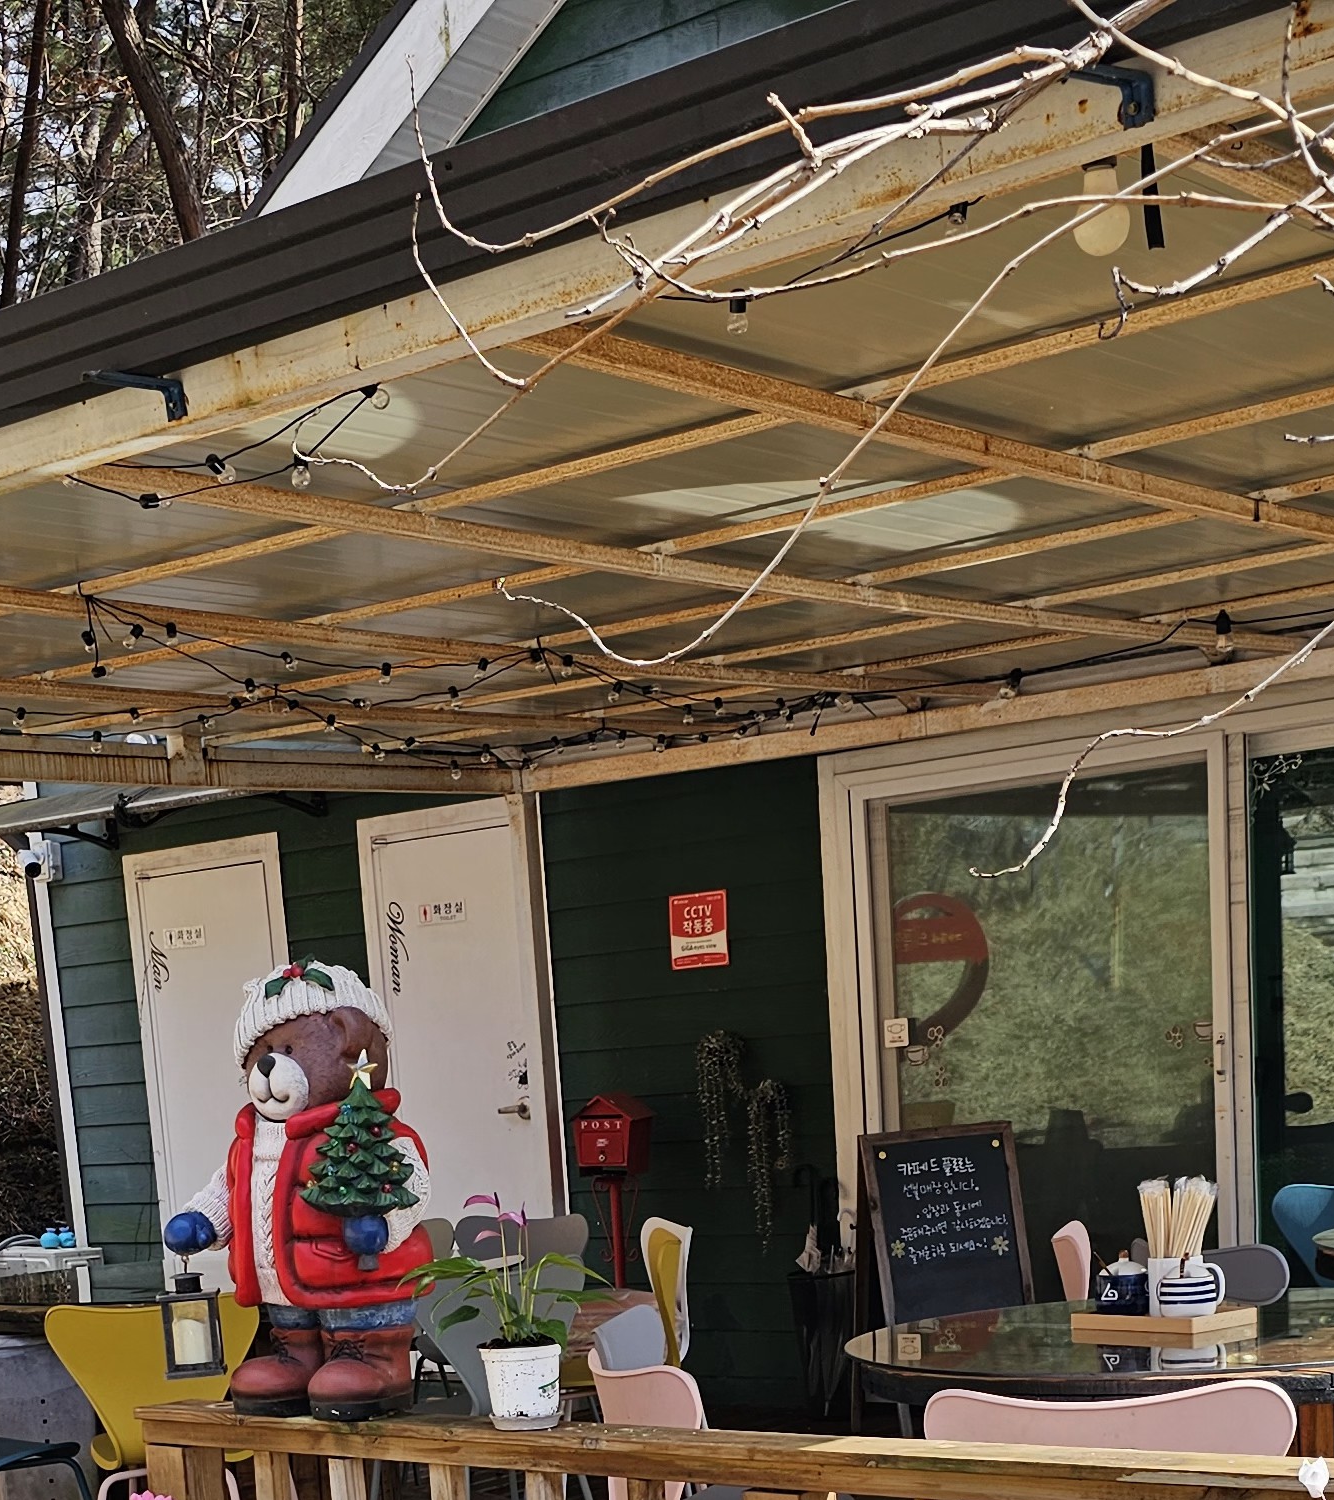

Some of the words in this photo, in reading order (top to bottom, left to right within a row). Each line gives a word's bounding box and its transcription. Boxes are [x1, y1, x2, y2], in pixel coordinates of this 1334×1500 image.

[433, 901, 463, 915] 화장실
[683, 904, 712, 919] CCTV
[683, 917, 714, 935] 작동중
[177, 927, 202, 941] 화장실
[386, 901, 410, 997] Woman
[149, 930, 170, 994] Man
[581, 1120, 623, 1130] POST
